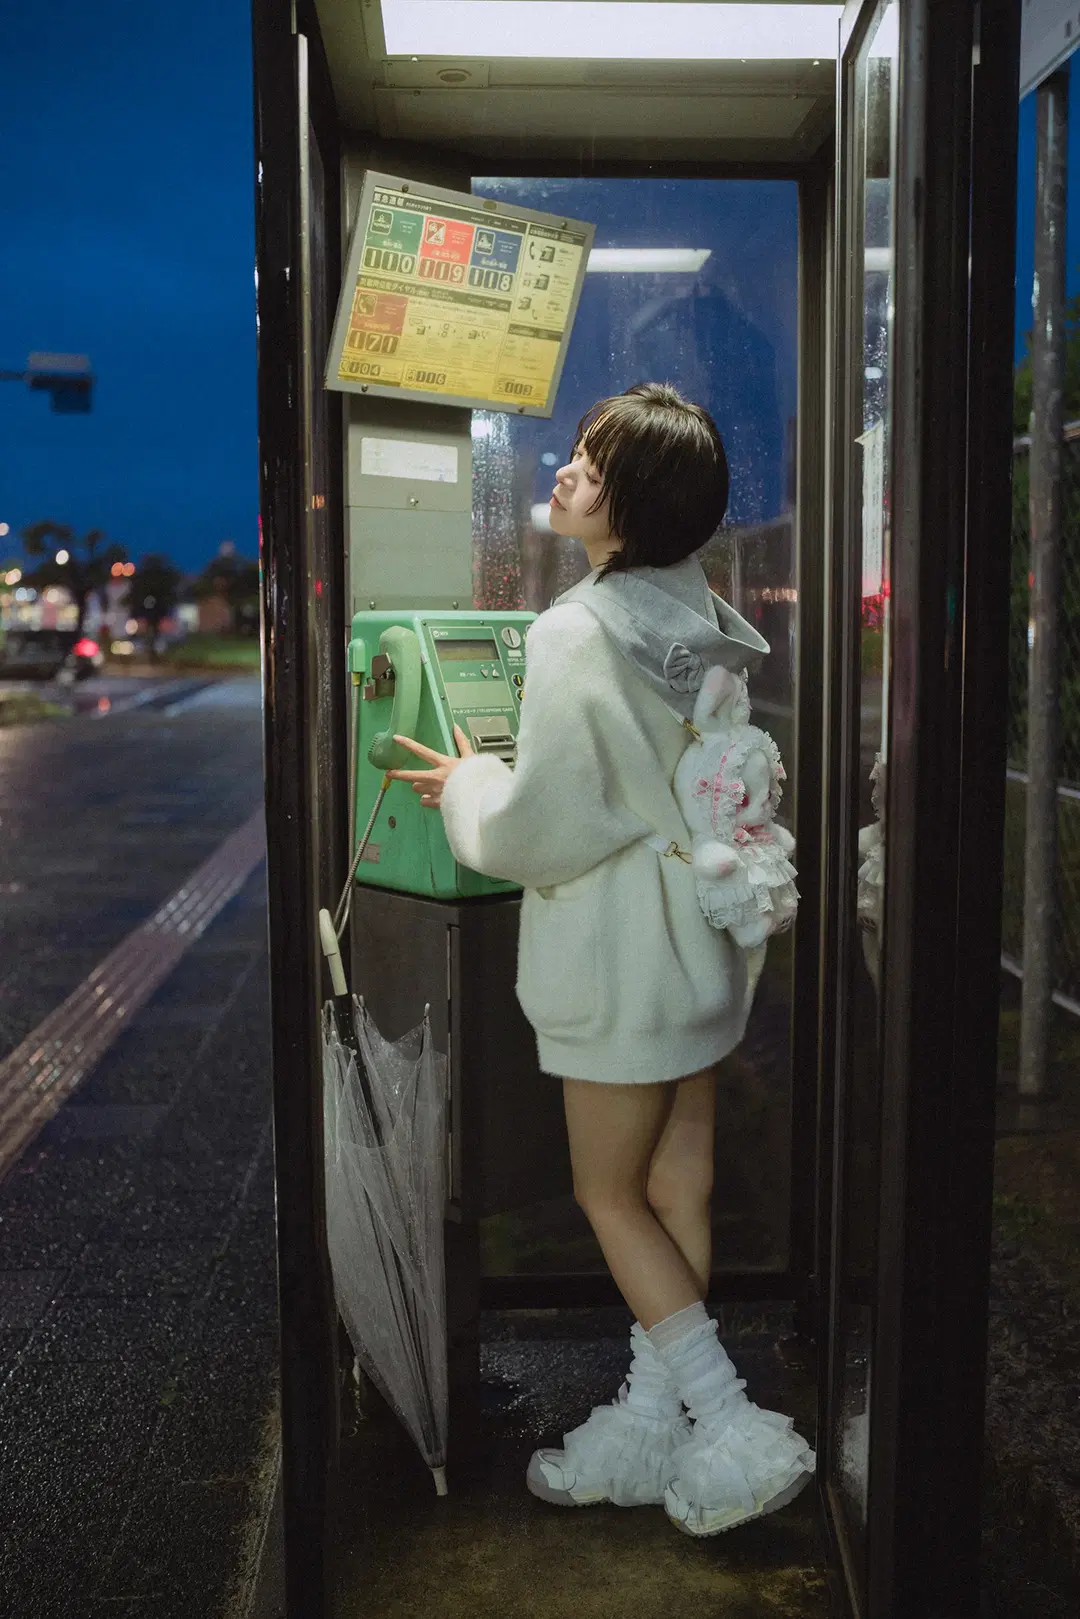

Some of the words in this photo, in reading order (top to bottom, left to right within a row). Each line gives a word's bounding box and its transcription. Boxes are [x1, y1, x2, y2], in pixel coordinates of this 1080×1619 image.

[370, 250, 413, 273] 110
[423, 260, 464, 283] 119
[473, 269, 511, 291] 118
[353, 332, 394, 353] 171
